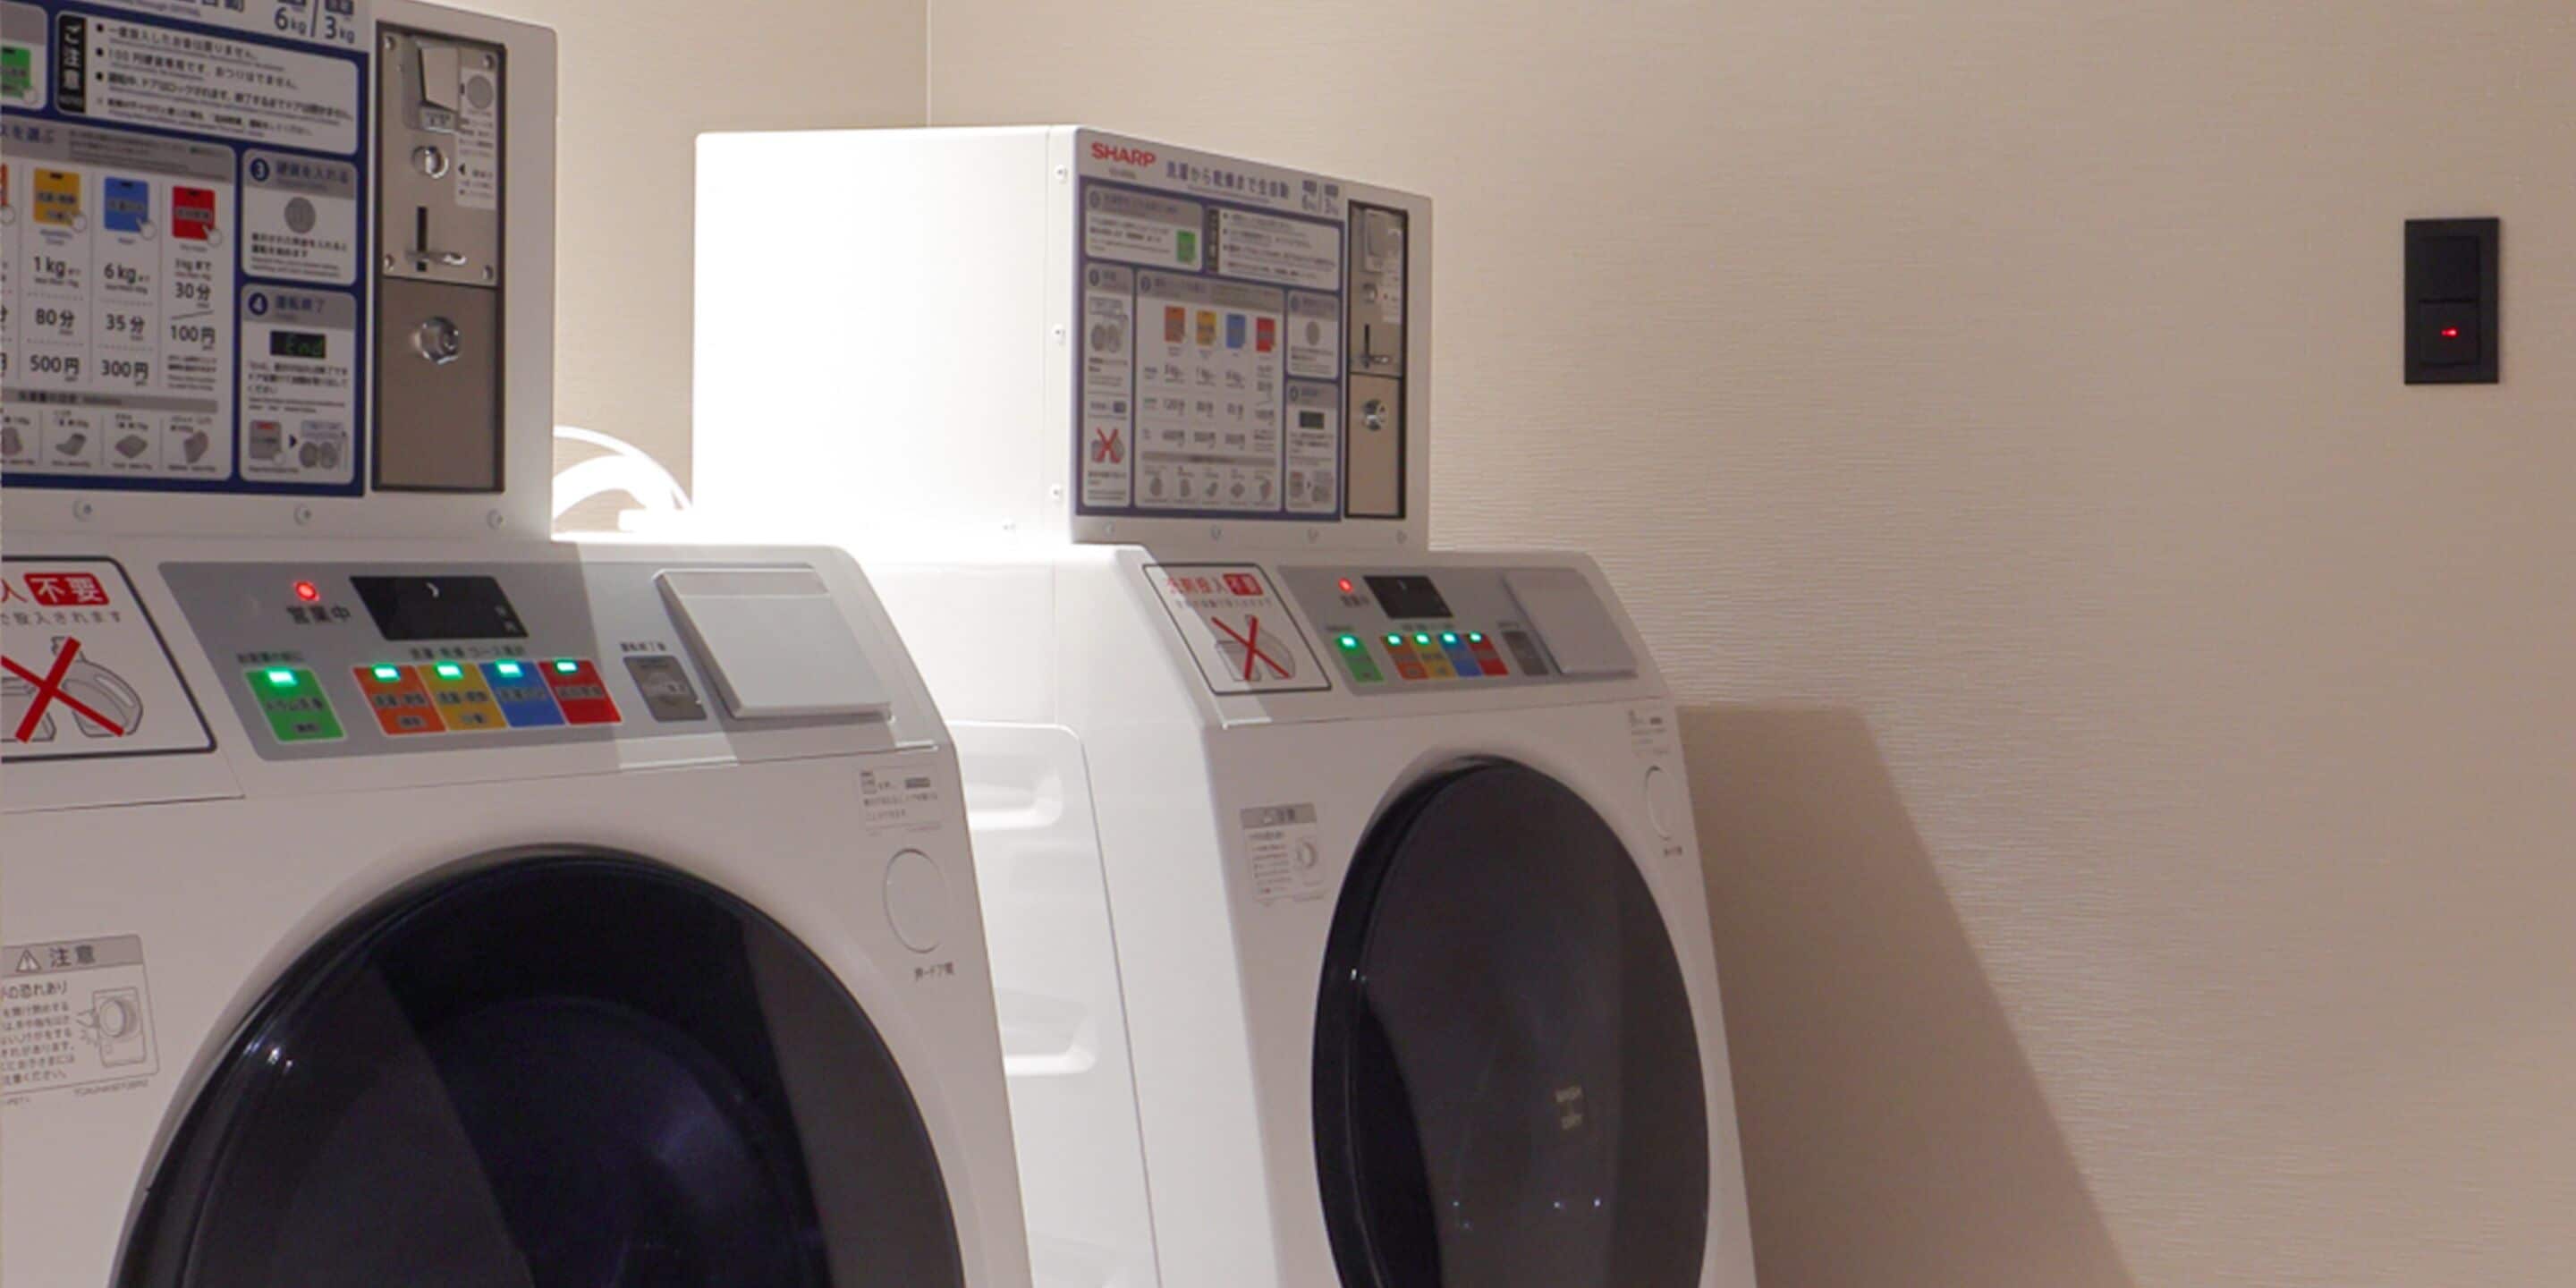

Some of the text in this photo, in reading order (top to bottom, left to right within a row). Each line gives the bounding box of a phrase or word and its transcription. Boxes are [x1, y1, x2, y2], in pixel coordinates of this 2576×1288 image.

[1091, 141, 1157, 168] SHARP
[30, 578, 106, 604] 不要
[287, 604, 351, 624] 営業中
[49, 945, 96, 968] 注意
